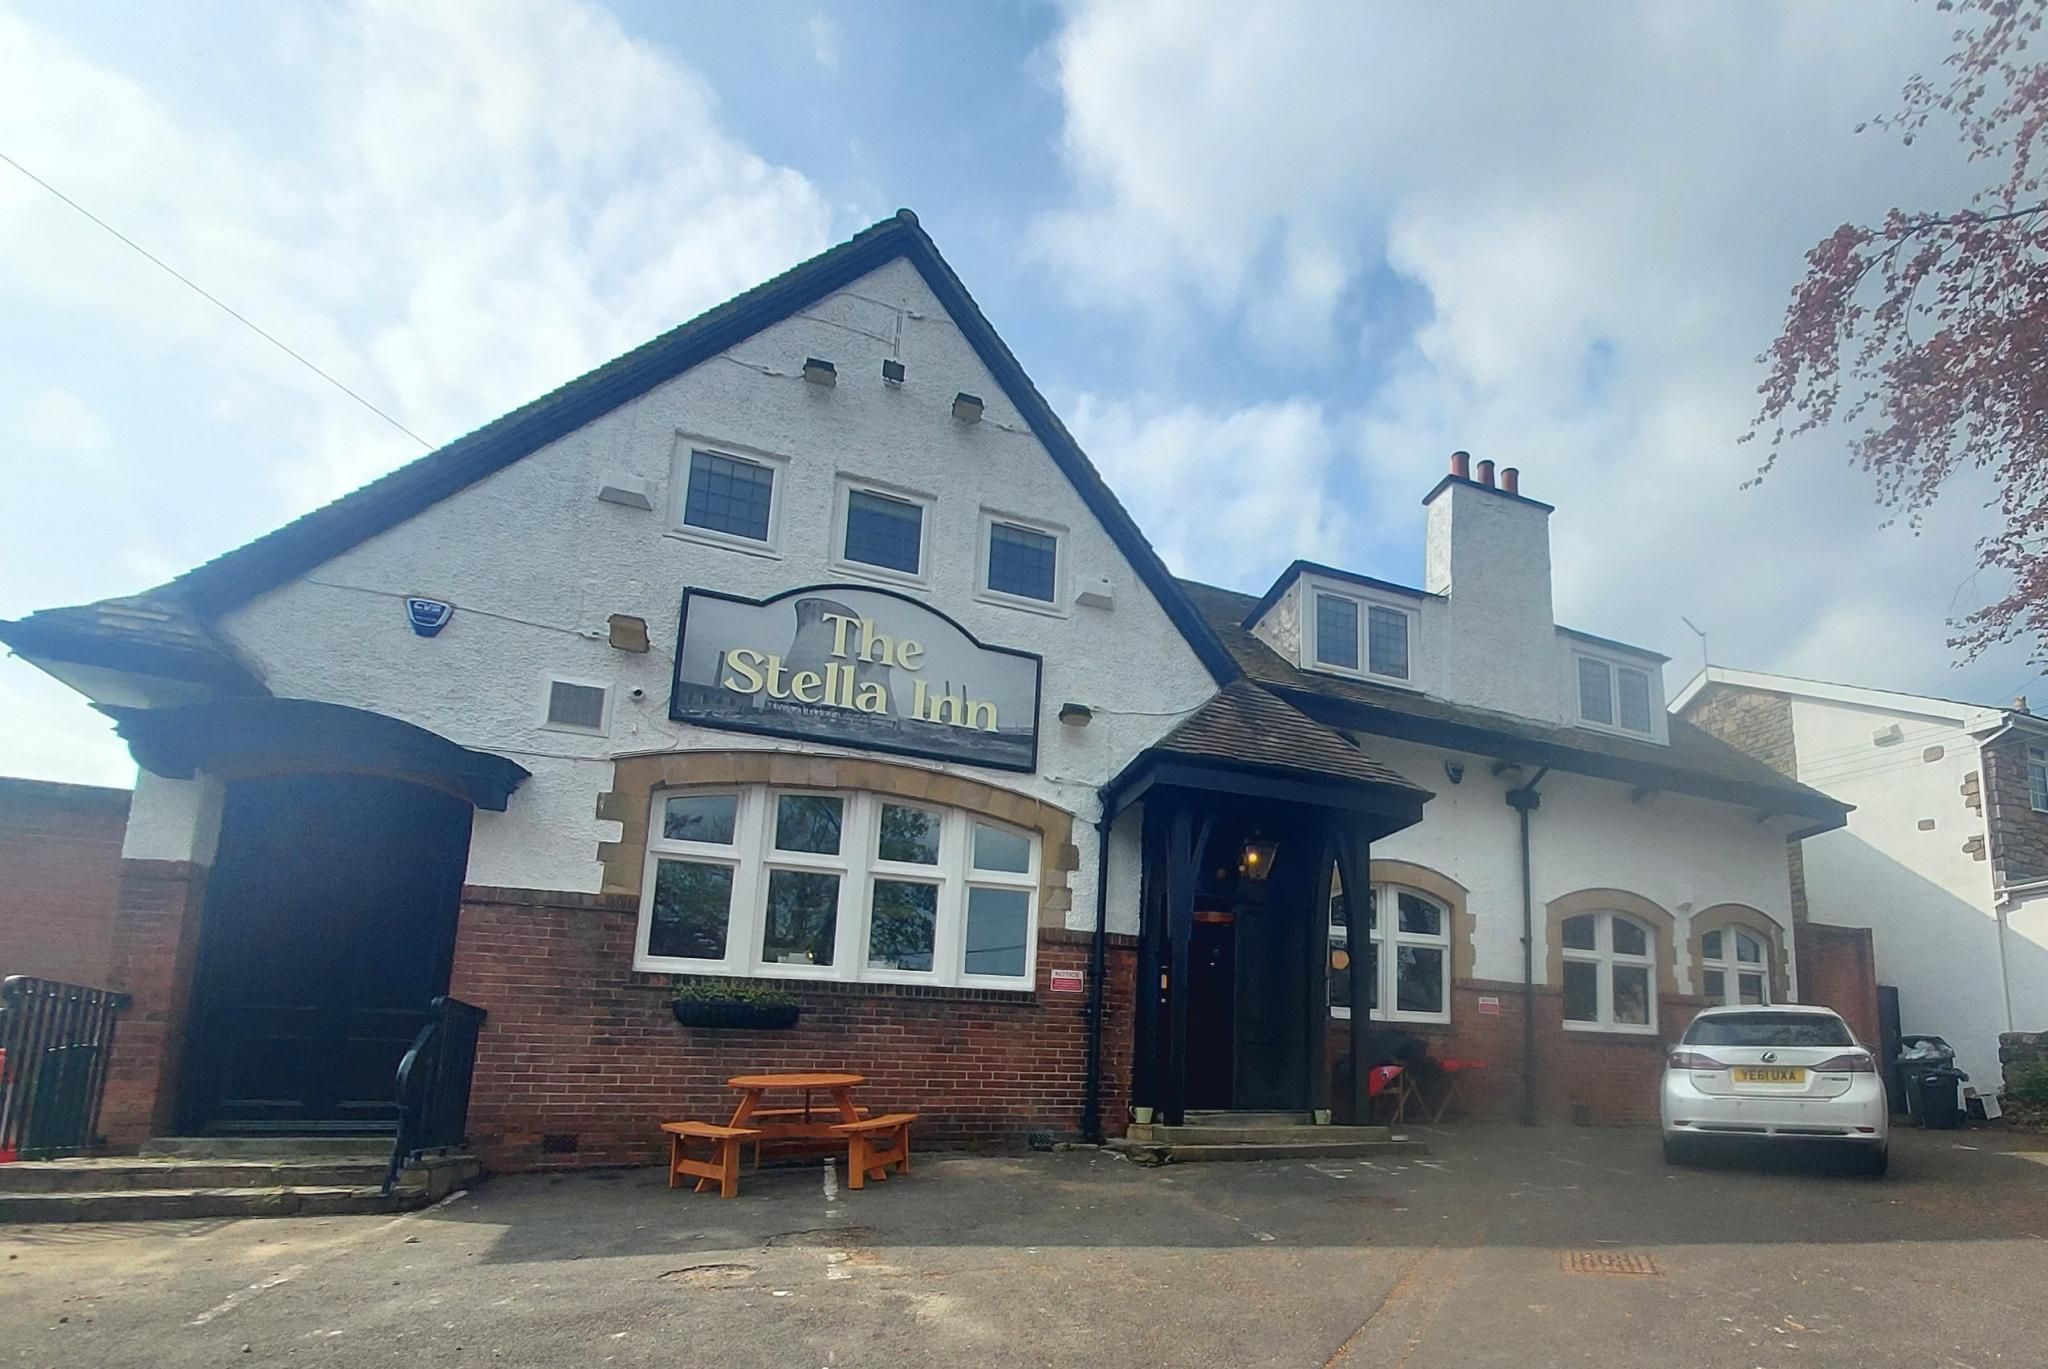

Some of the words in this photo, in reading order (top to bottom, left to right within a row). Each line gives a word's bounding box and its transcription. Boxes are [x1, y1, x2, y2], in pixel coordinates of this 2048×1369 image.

[822, 613, 924, 671] The
[723, 648, 888, 715] Stella
[911, 679, 999, 732] Inn
